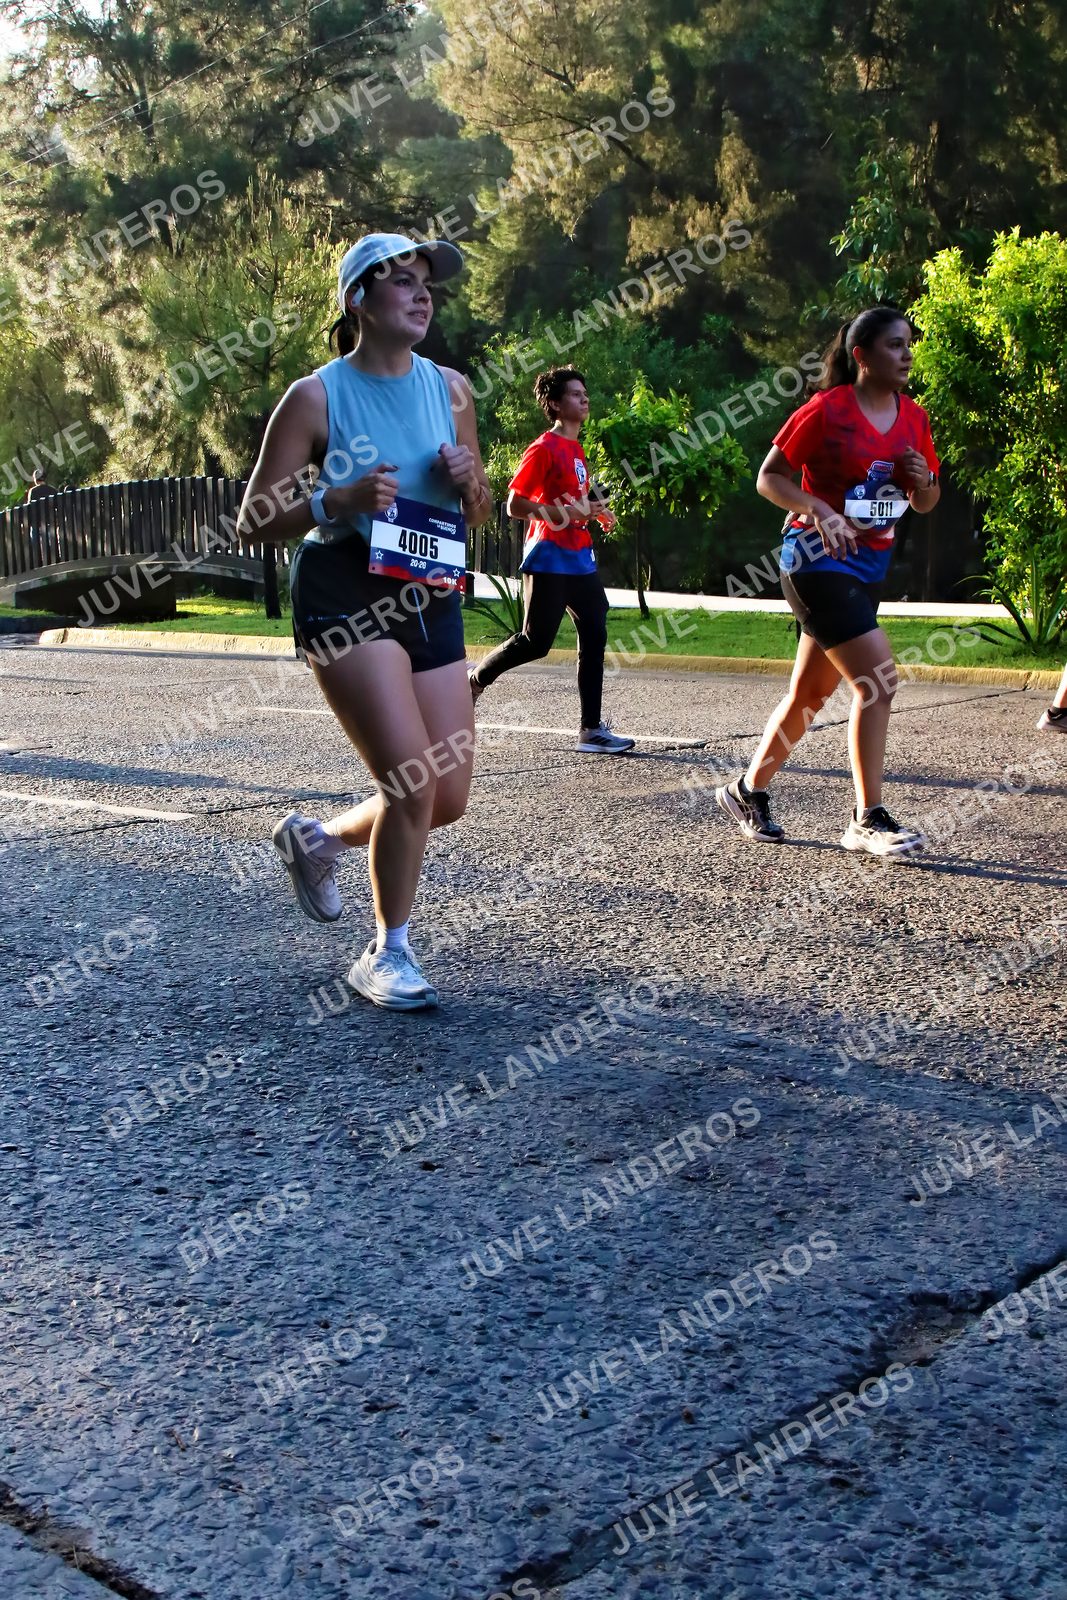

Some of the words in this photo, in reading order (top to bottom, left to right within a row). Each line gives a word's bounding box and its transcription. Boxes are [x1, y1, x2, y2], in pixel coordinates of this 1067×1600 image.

[870, 501, 893, 517] 5011
[398, 529, 439, 559] 4005
[443, 577, 457, 586] 10K
